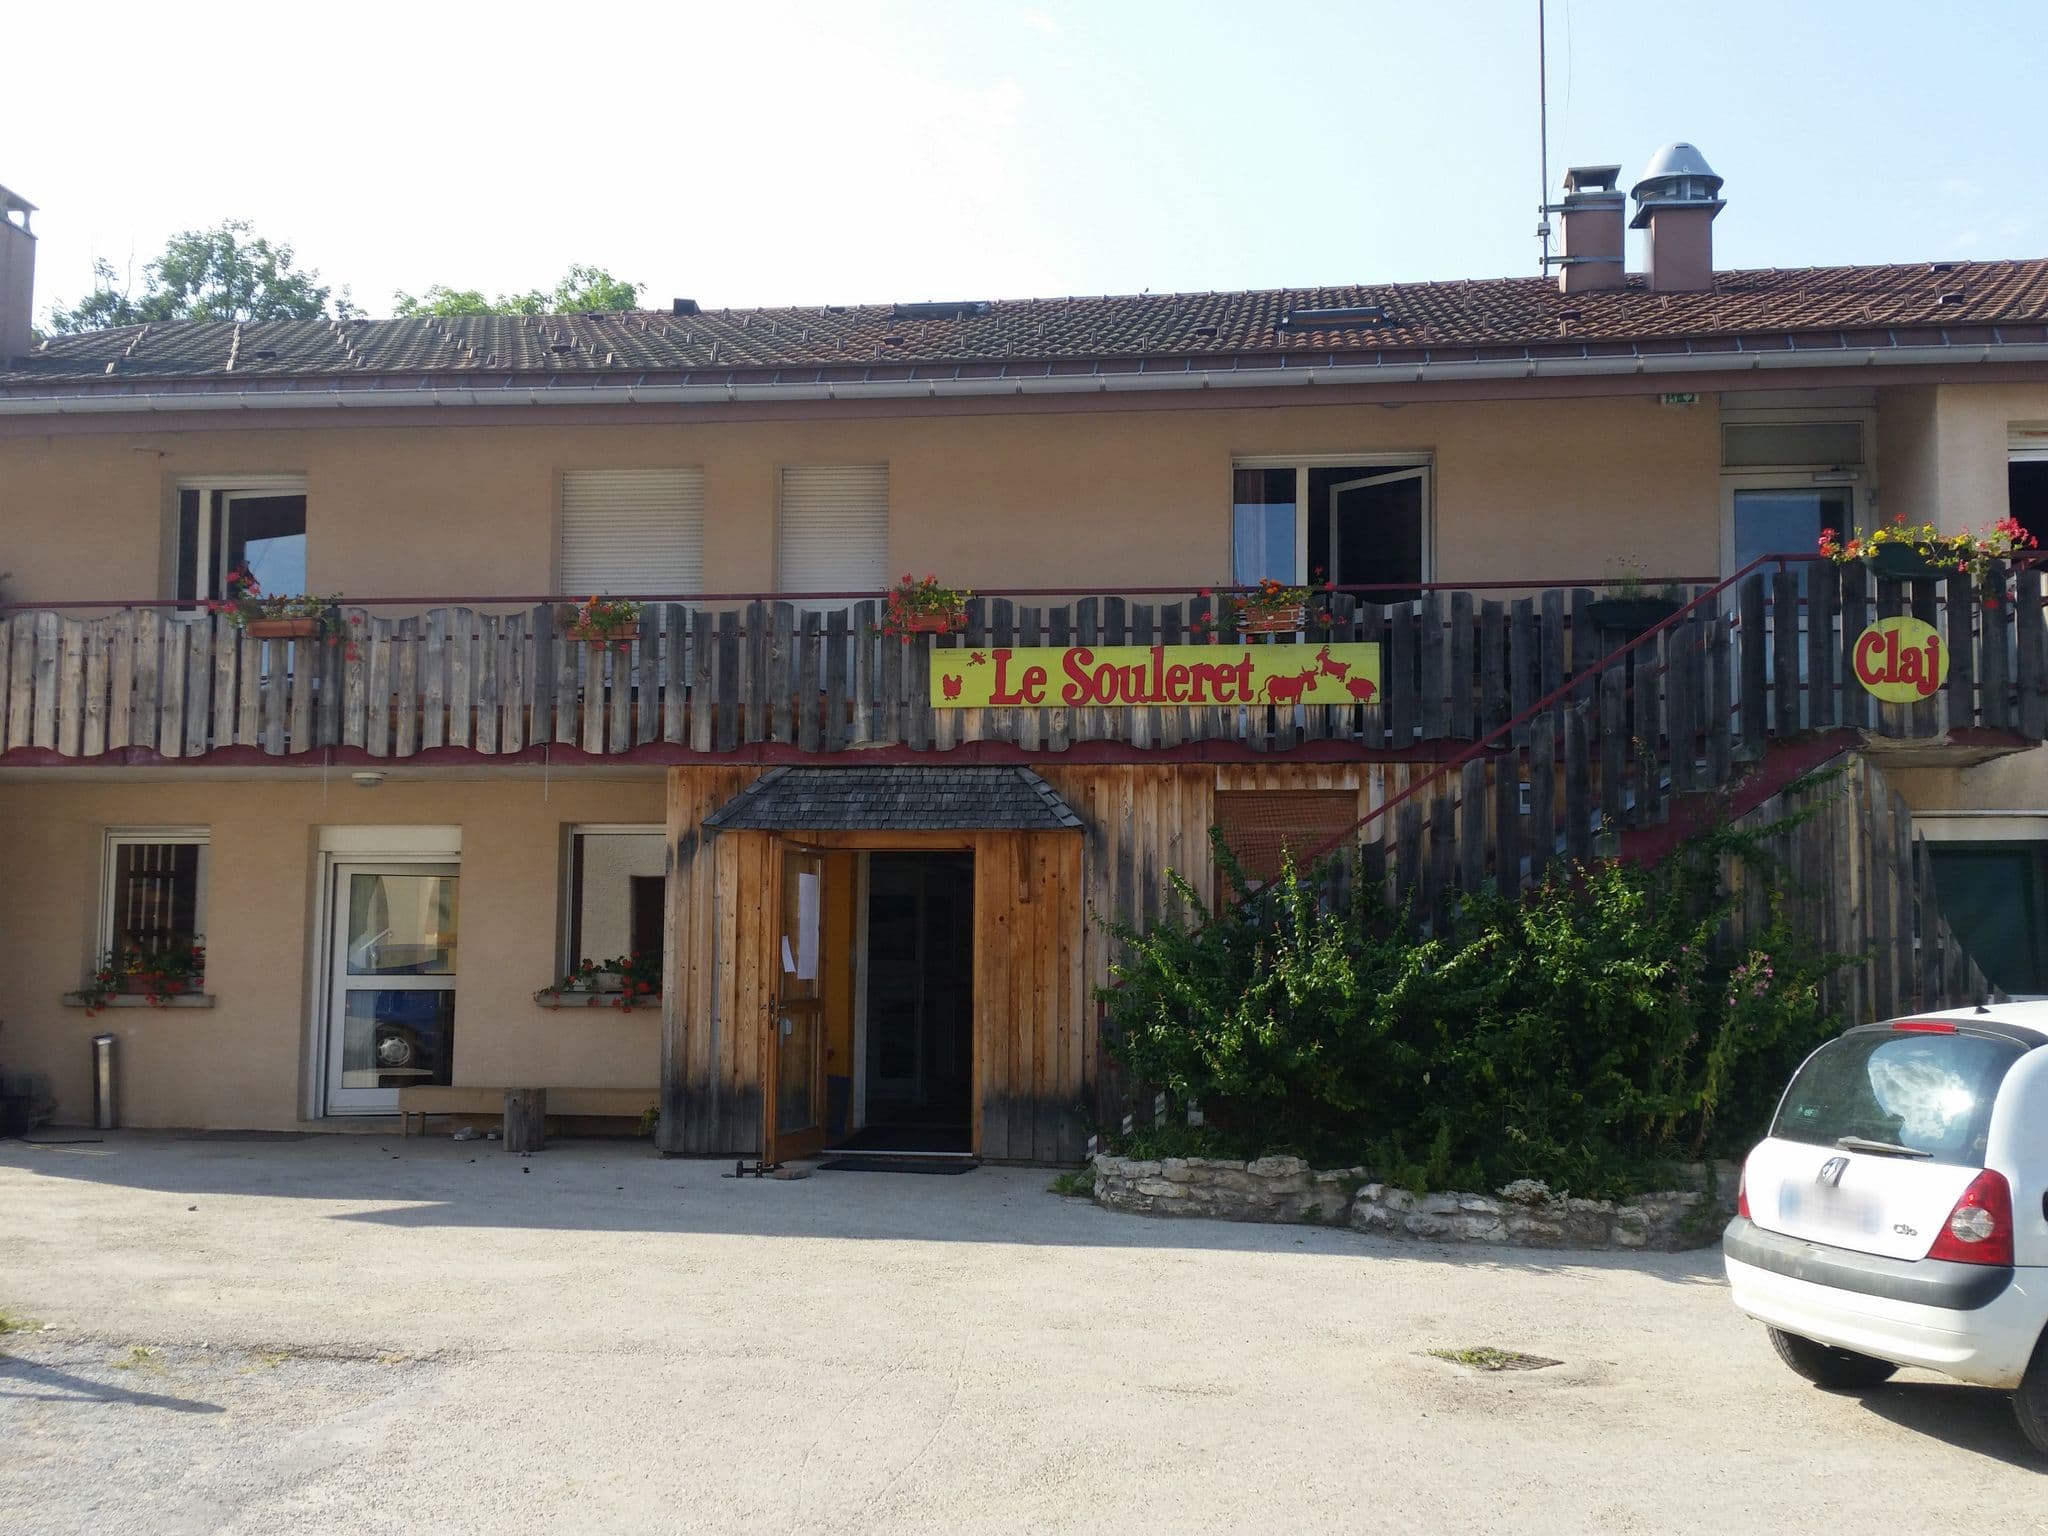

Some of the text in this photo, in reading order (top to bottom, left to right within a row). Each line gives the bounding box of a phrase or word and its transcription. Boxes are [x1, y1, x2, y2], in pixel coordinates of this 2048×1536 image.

[989, 646, 1255, 707] Le Souleret
[1856, 629, 1939, 695] Claj
